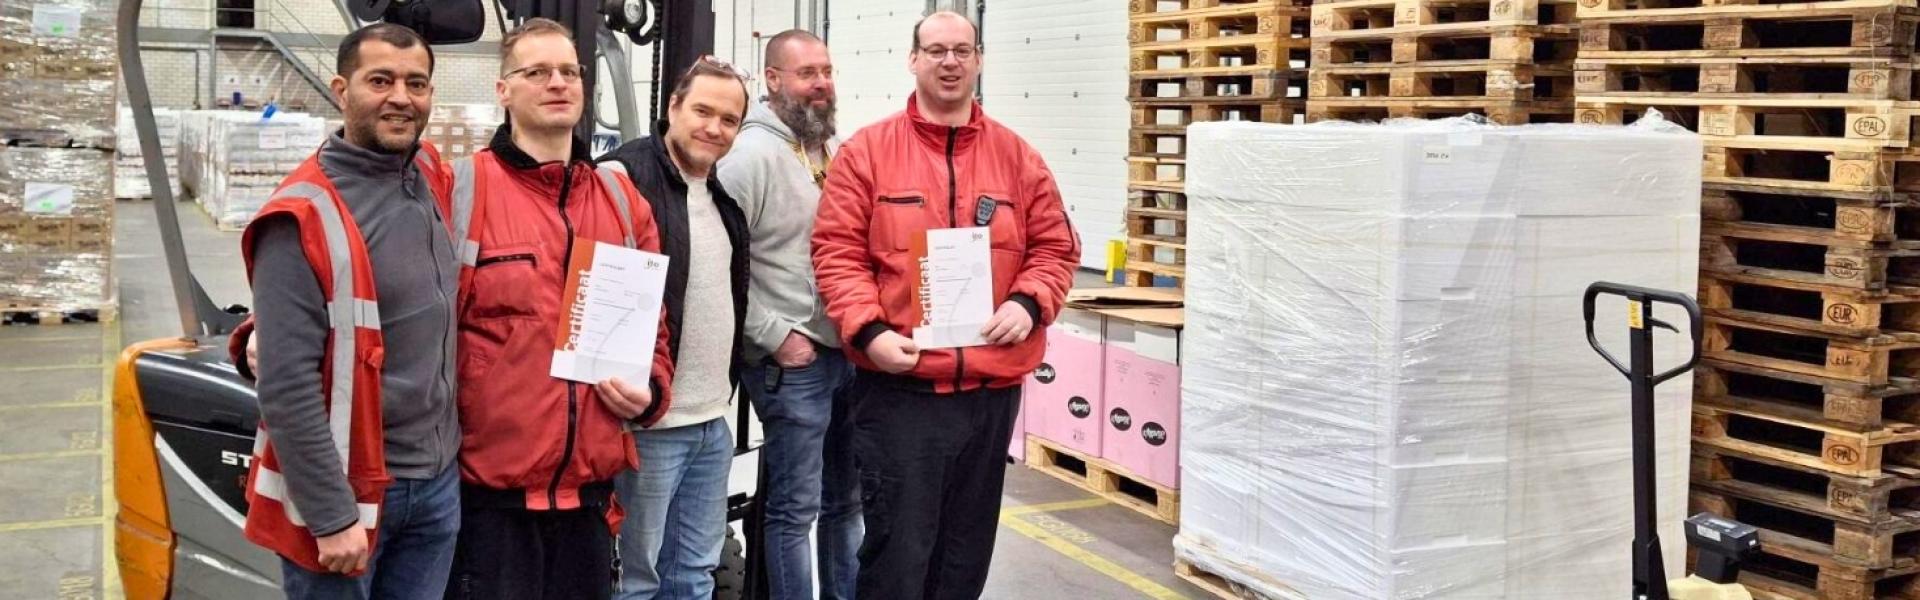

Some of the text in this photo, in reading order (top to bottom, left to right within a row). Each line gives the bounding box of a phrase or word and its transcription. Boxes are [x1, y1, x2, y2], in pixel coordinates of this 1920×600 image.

[1857, 119, 1878, 132] EPAL
[917, 255, 933, 328] Certificaat
[563, 268, 592, 352] Certificaat
[1833, 305, 1852, 320] EUR
[1831, 447, 1852, 462] EPAL
